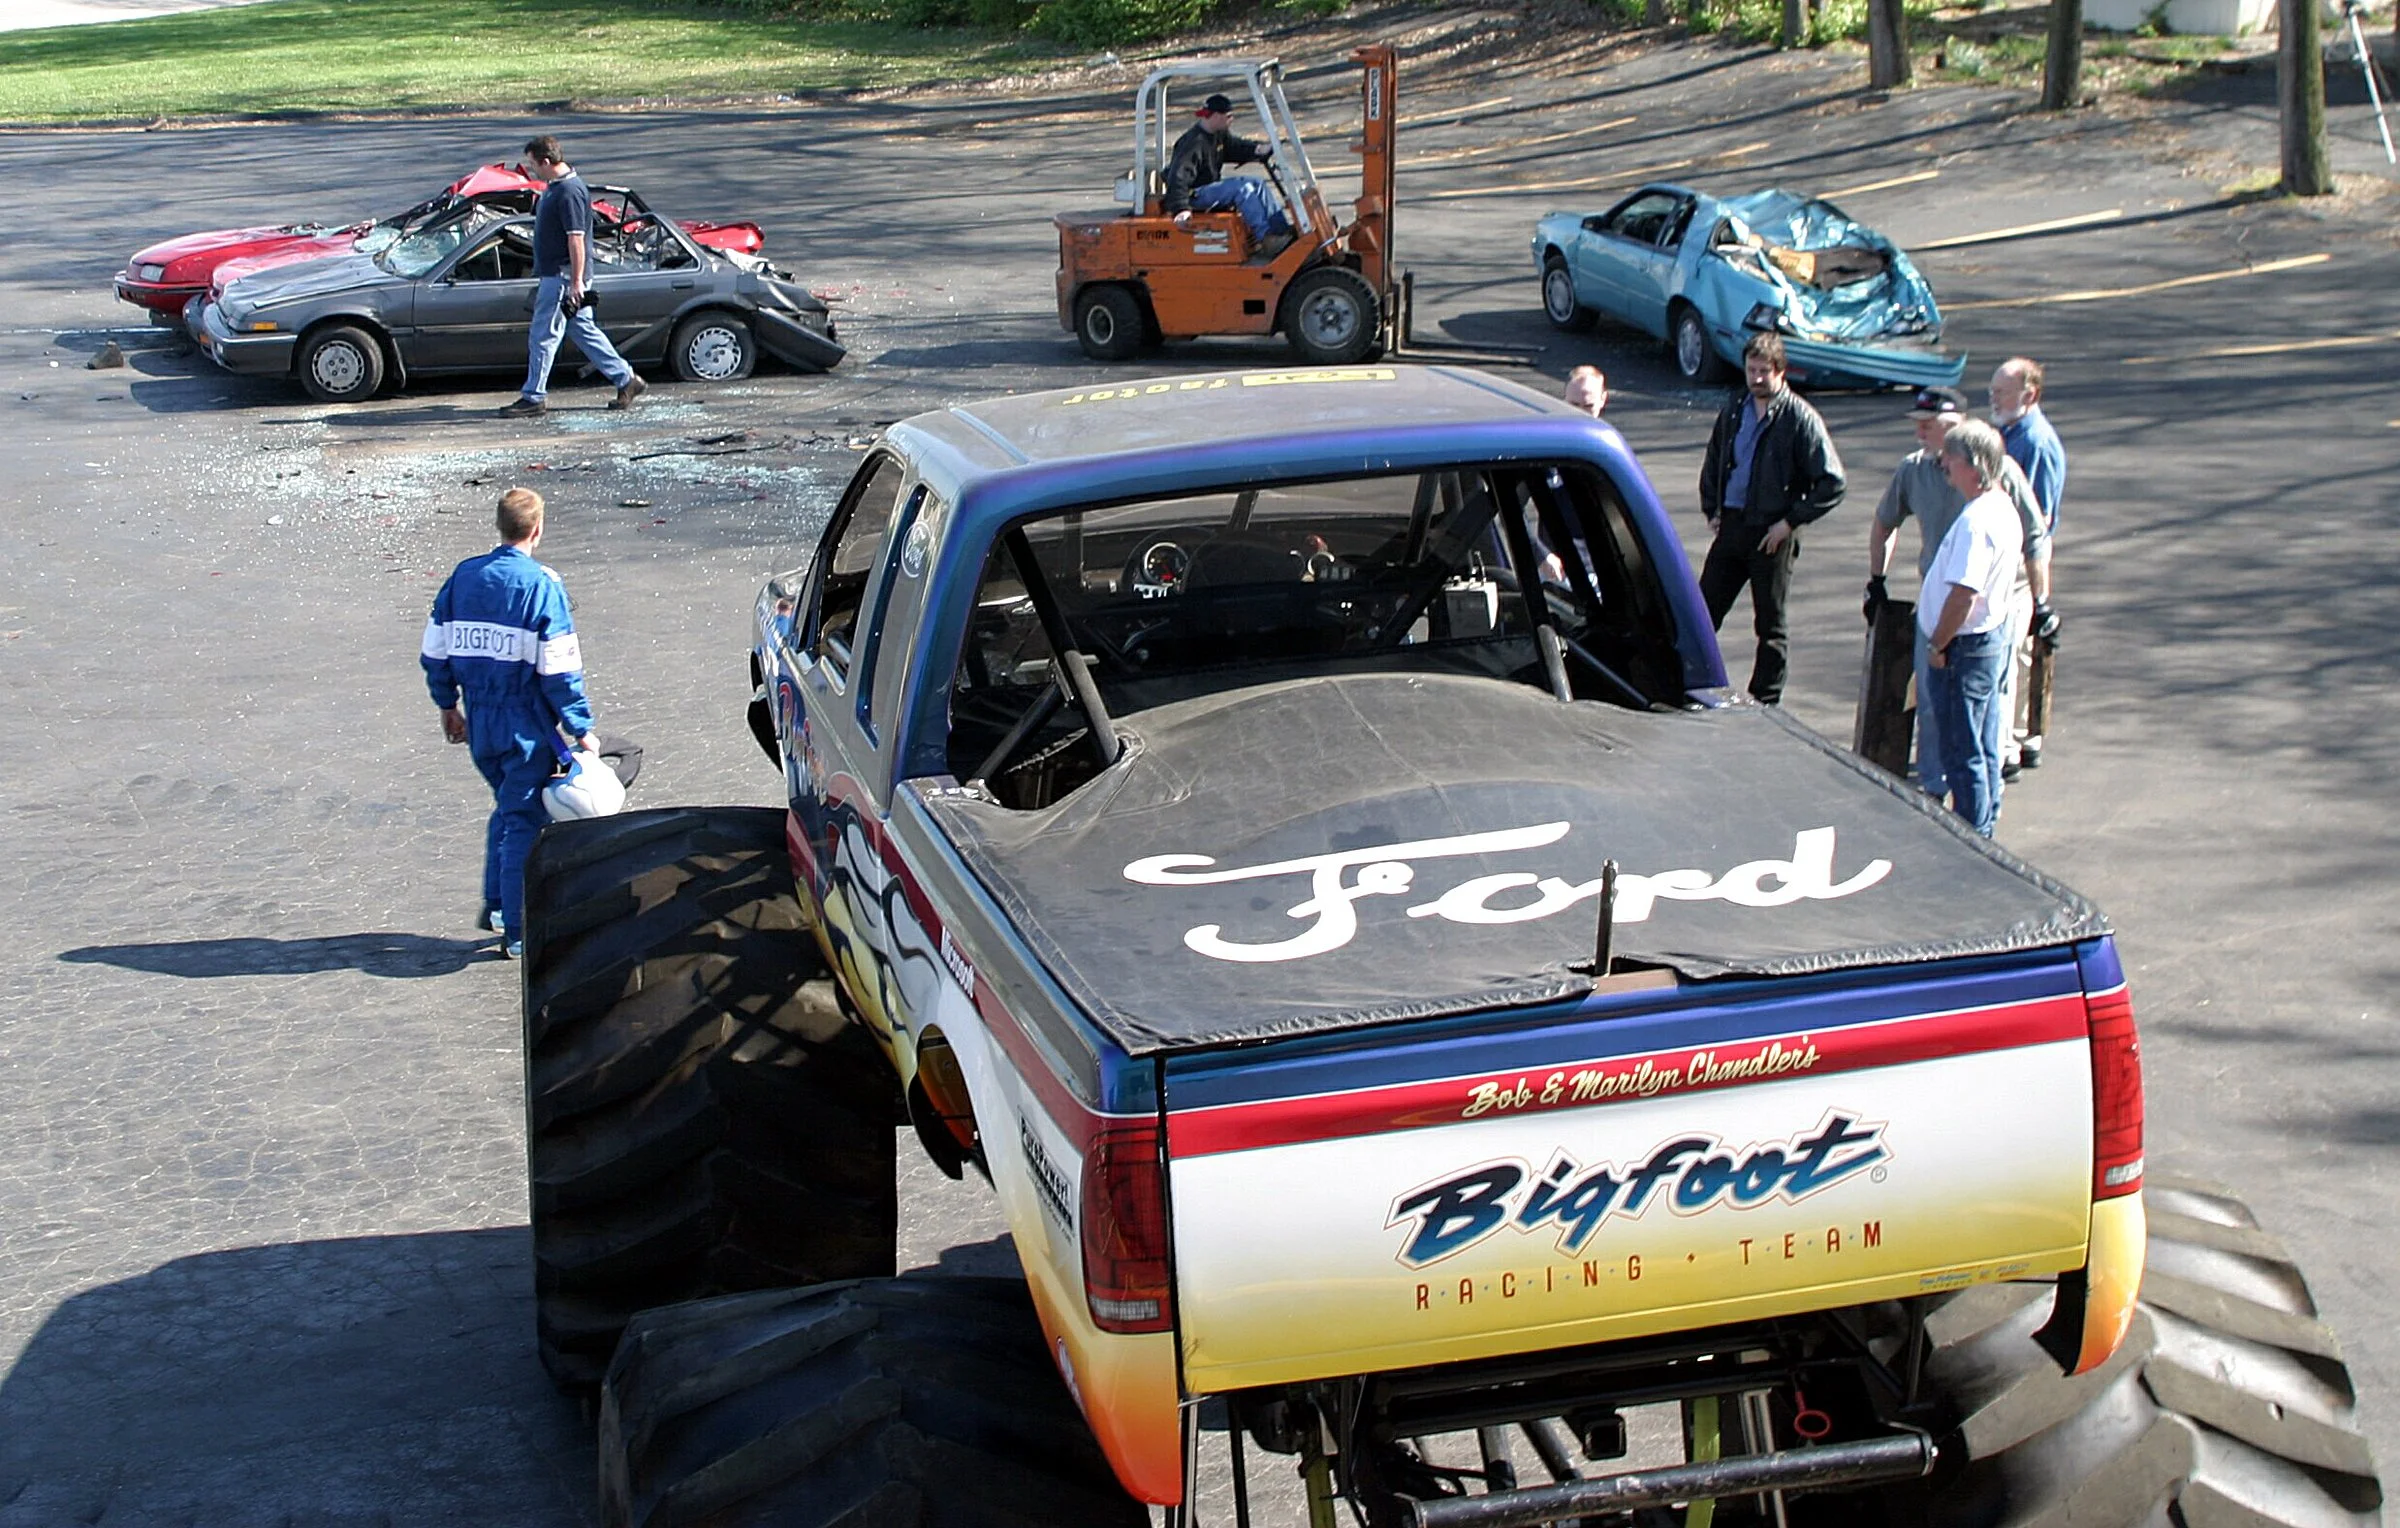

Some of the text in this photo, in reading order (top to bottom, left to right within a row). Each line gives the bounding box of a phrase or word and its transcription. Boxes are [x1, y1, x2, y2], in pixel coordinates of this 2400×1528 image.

[1122, 821, 1893, 962] Ford
[1461, 1037, 1821, 1118] Bob & Marilyn Chandler's
[1393, 1111, 1889, 1266] Bigfoot
